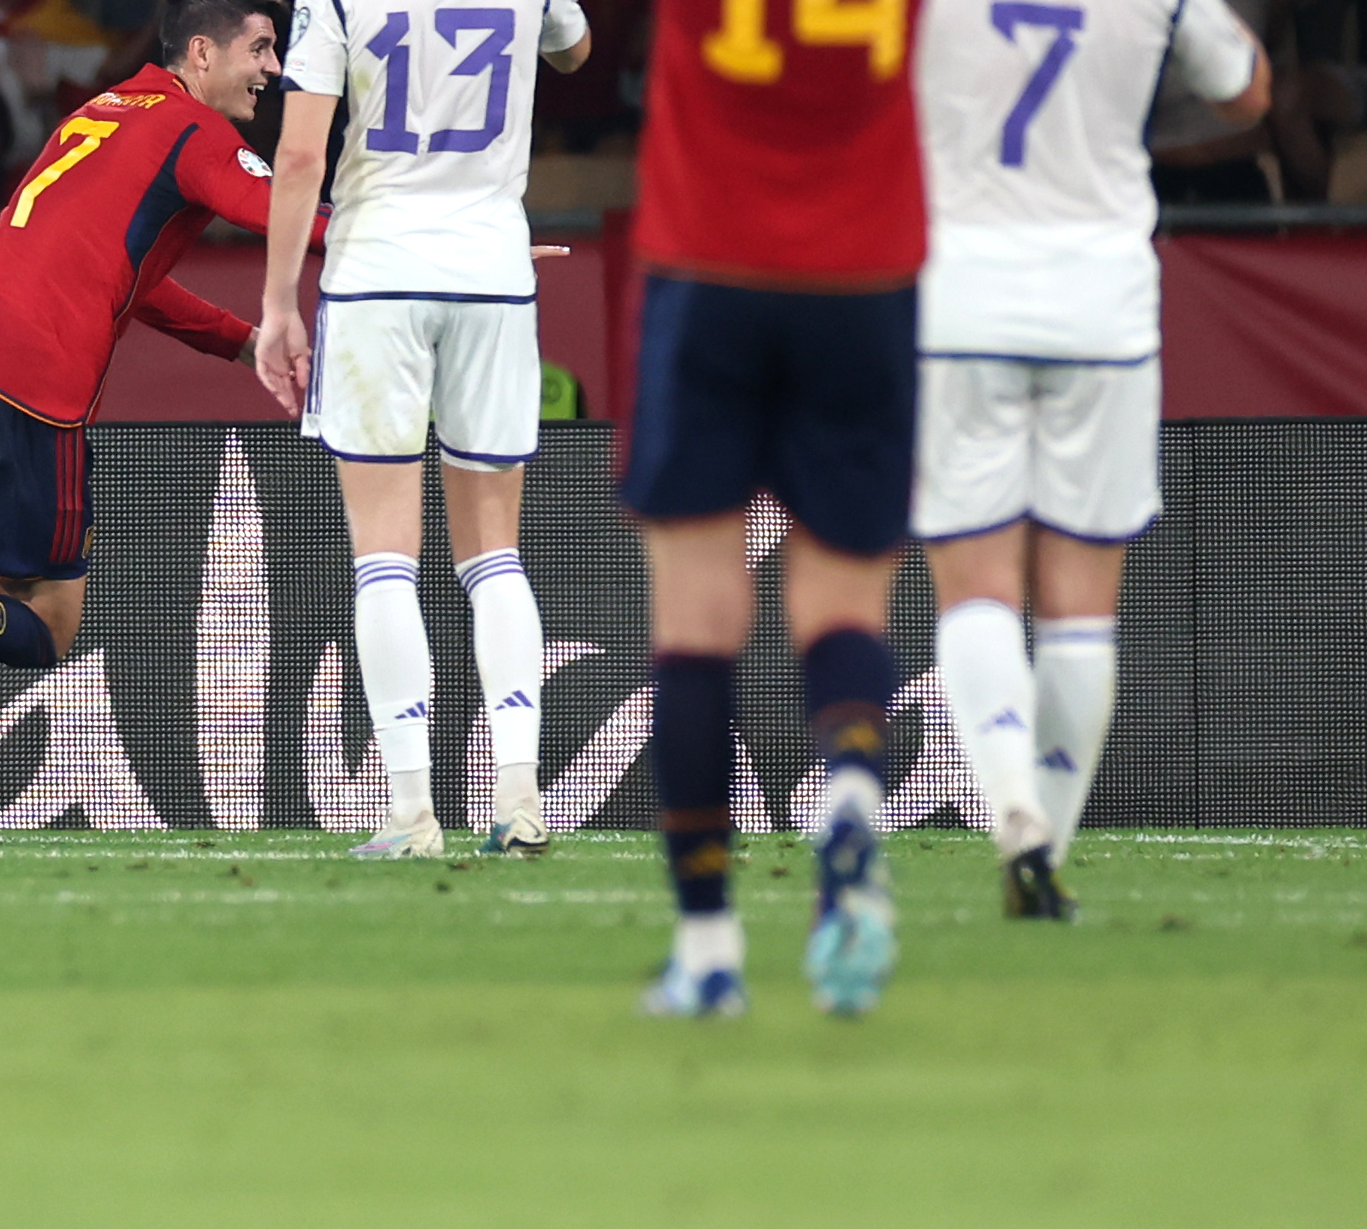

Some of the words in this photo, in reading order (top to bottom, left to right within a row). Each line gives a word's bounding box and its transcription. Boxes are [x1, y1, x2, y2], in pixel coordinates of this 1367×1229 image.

[365, 7, 516, 155] 13
[988, 0, 1086, 168] 7
[10, 116, 120, 228] 7
